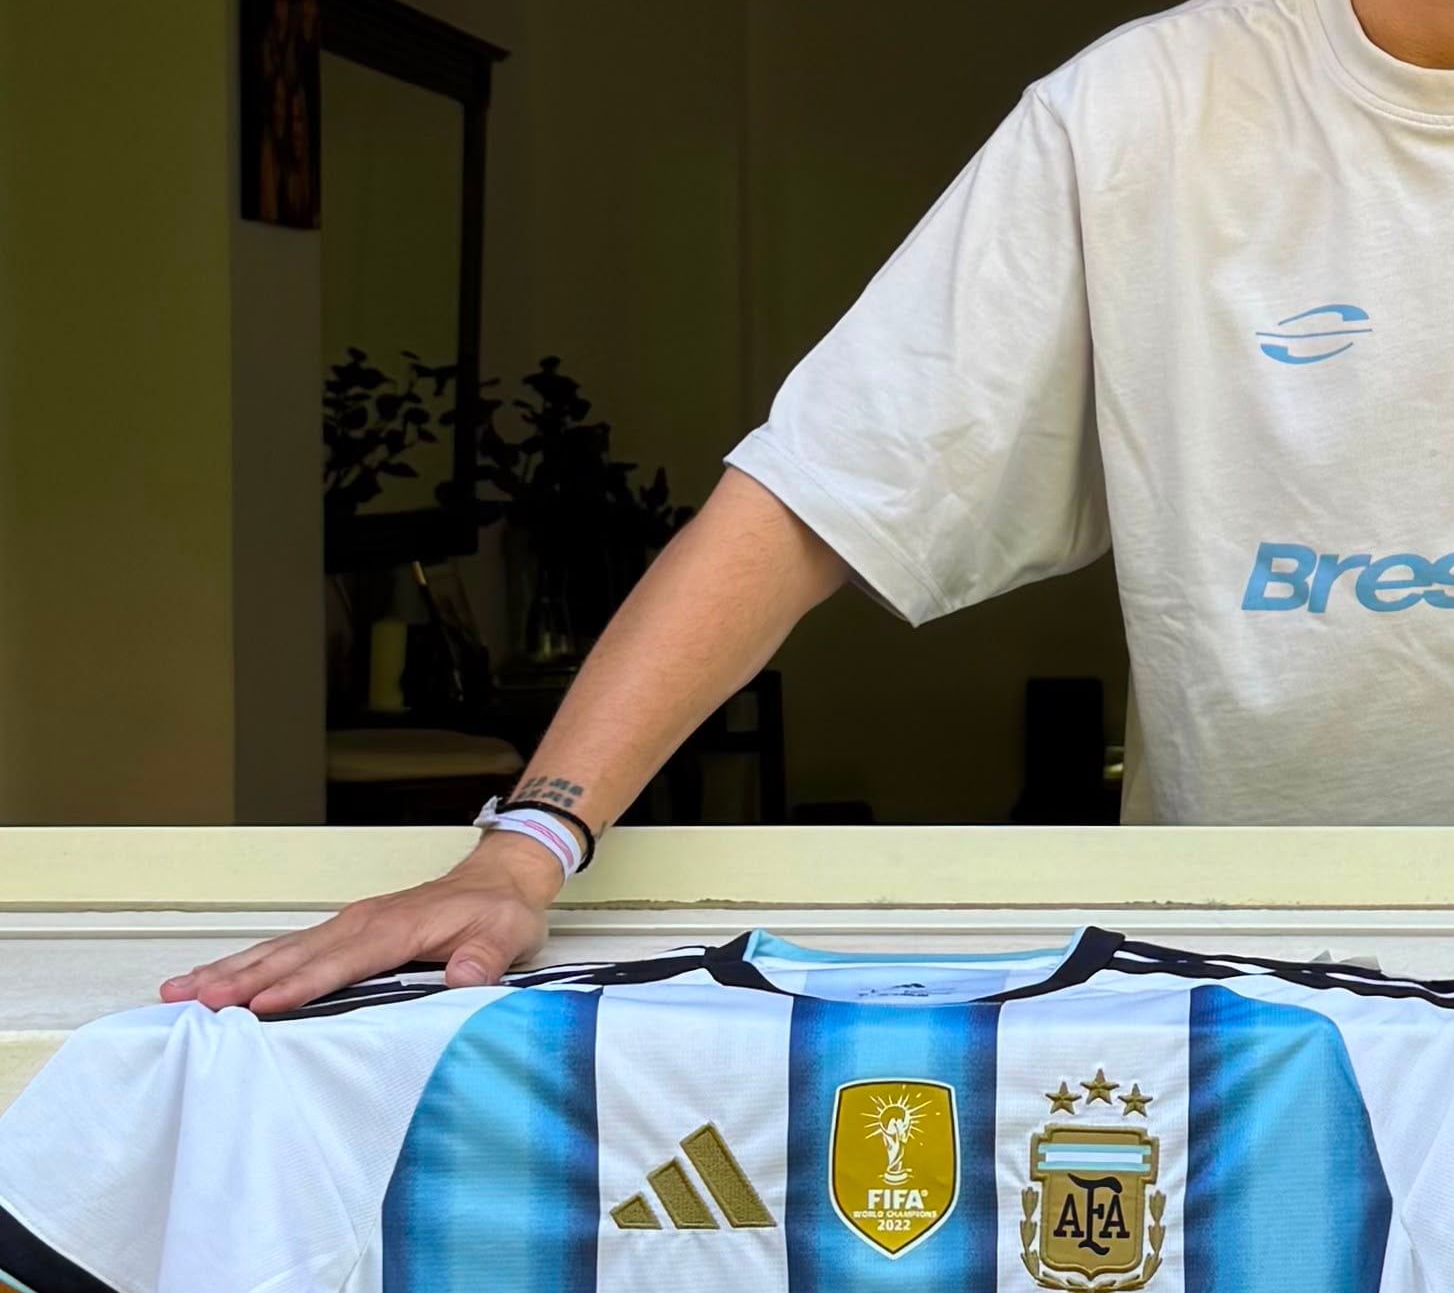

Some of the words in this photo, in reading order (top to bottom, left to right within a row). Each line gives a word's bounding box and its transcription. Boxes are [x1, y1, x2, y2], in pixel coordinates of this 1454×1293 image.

[852, 1210, 884, 1219] WORLD
[1053, 1173, 1130, 1256] AFA
[877, 1219, 911, 1231] 2022
